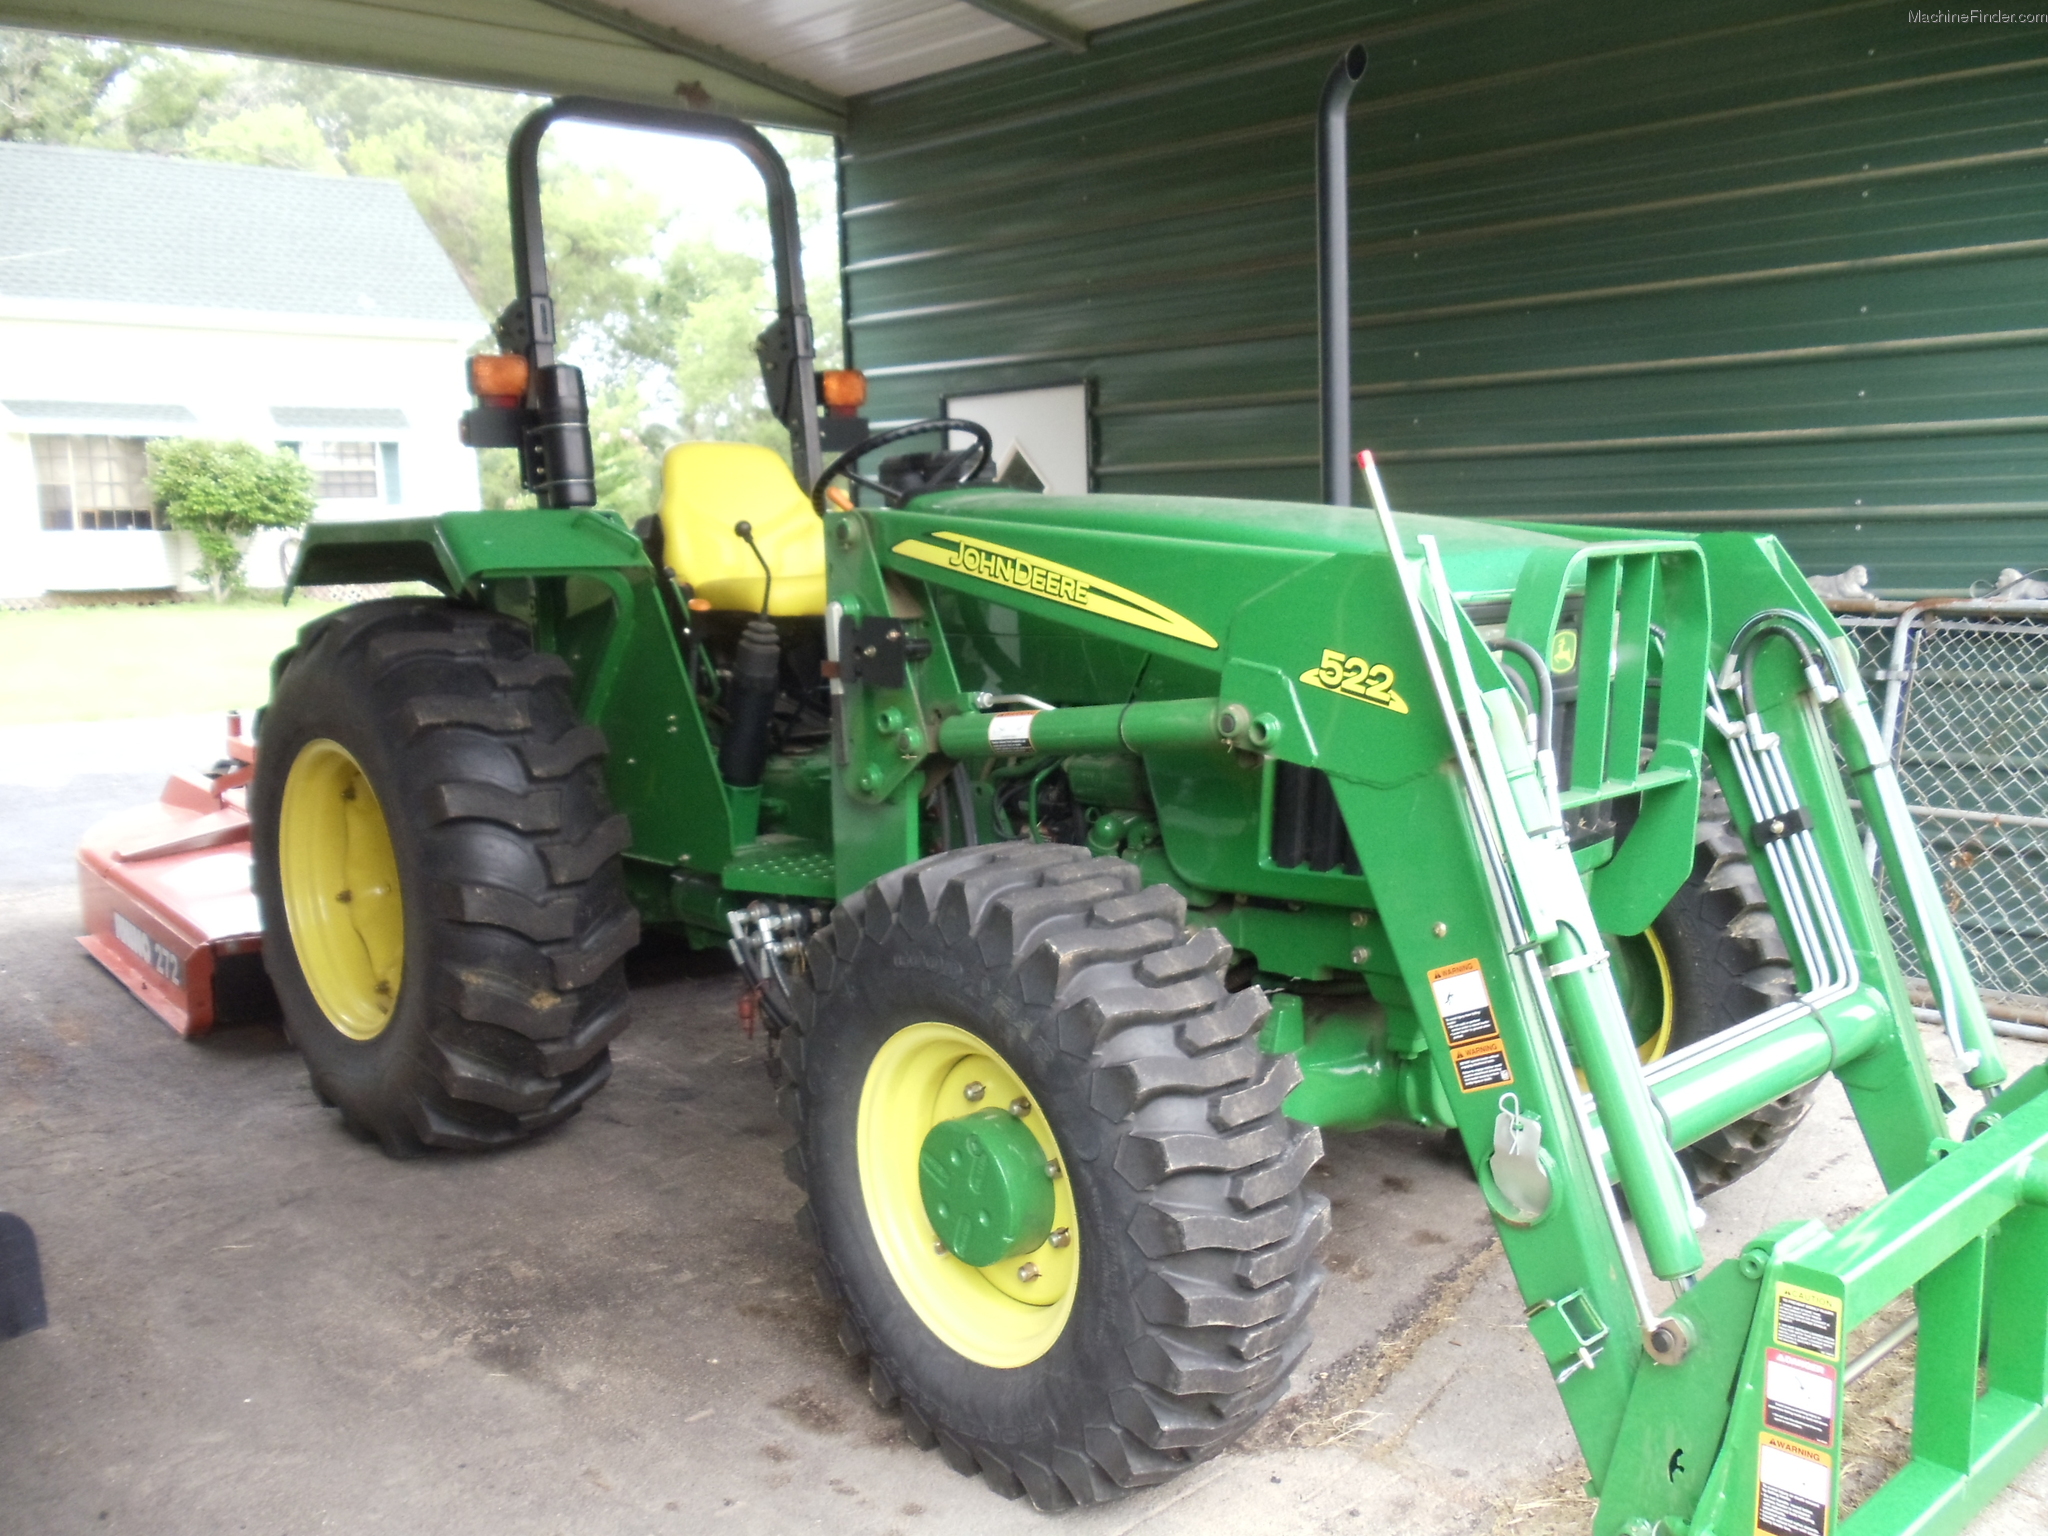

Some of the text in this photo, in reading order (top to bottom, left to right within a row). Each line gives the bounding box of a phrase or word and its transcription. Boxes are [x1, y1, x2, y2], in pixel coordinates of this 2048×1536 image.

[949, 541, 1091, 605] JOHN DEERE
[1318, 648, 1395, 704] 522
[1441, 962, 1474, 977] WARNING
[1465, 1043, 1498, 1056] WARNING
[1791, 1290, 1833, 1307] CAUTION
[1776, 1440, 1820, 1461] WARNING
